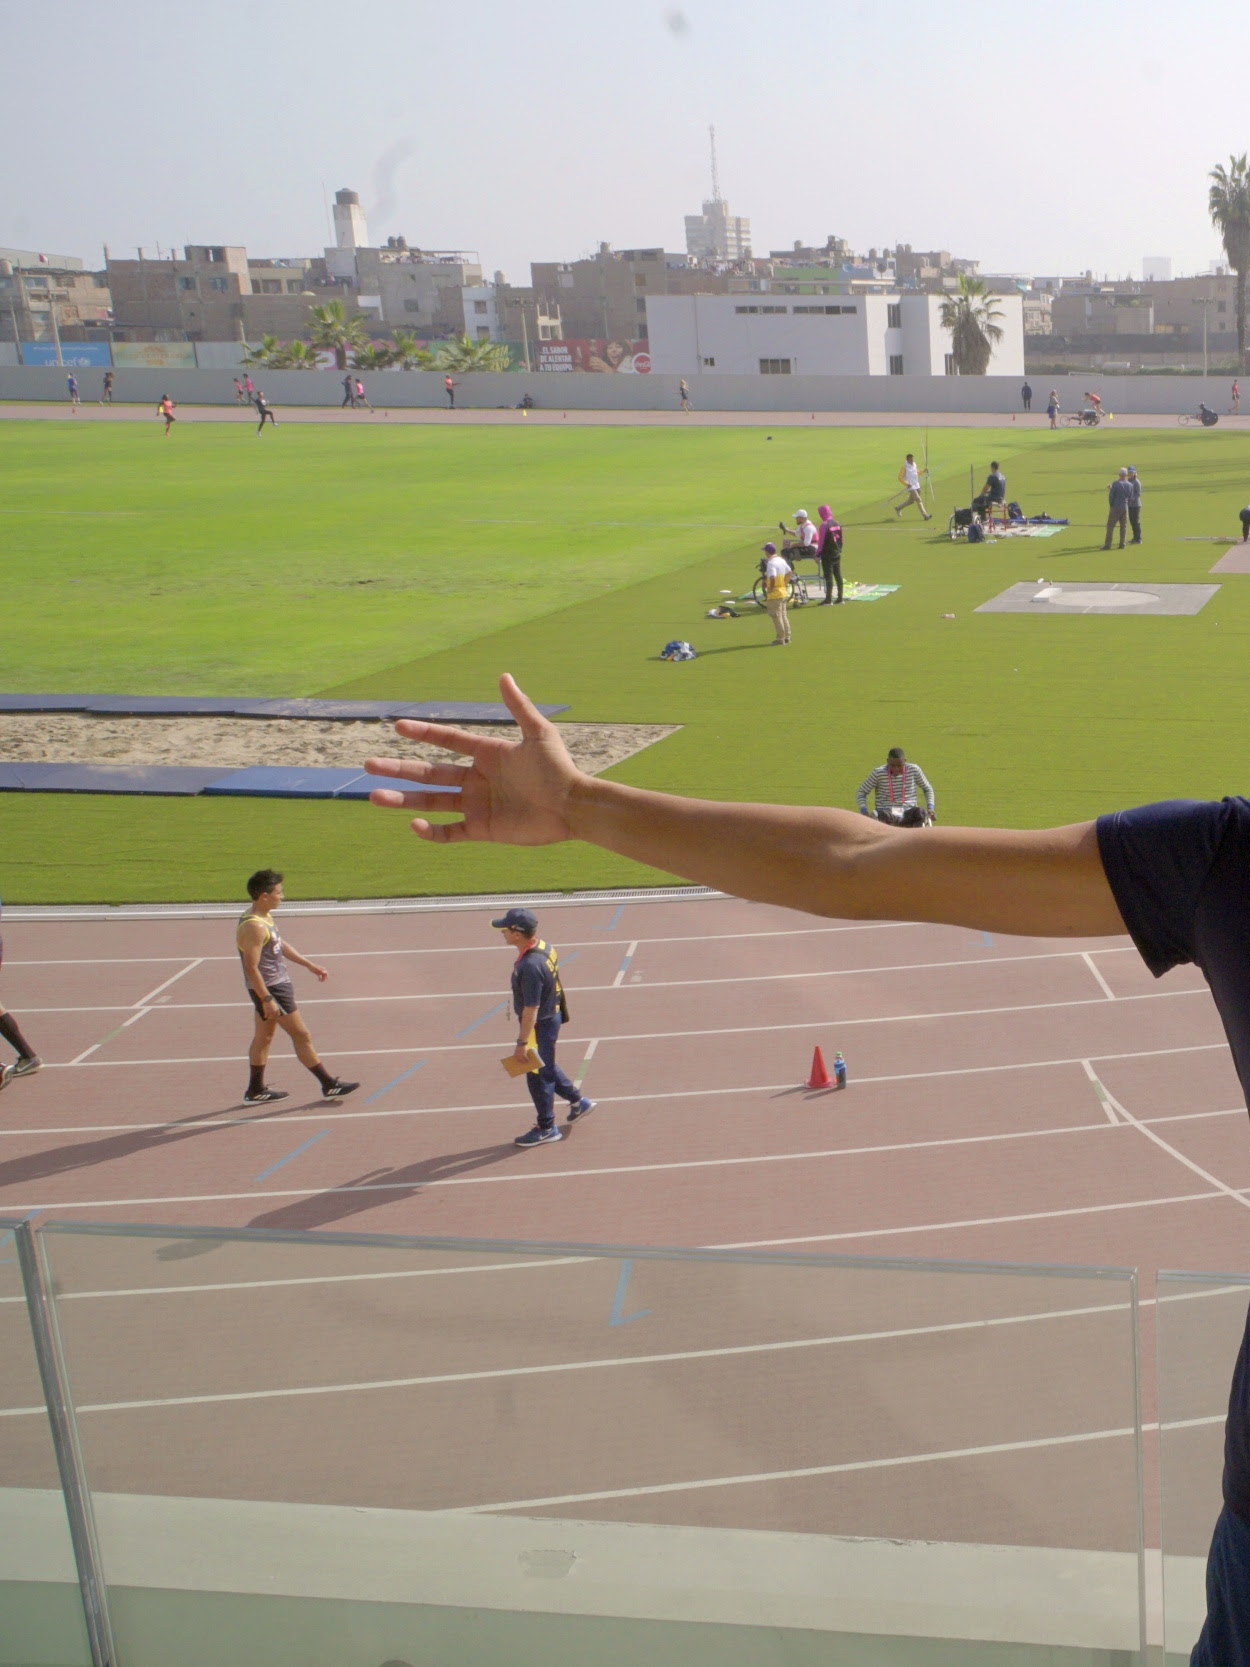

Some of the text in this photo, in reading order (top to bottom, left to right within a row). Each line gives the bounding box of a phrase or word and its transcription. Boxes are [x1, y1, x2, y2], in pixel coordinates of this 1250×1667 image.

[550, 346, 568, 354] SABOR
[45, 357, 78, 367] uncef
[540, 355, 572, 363] DE ALENTAR
[545, 363, 552, 372] TU
